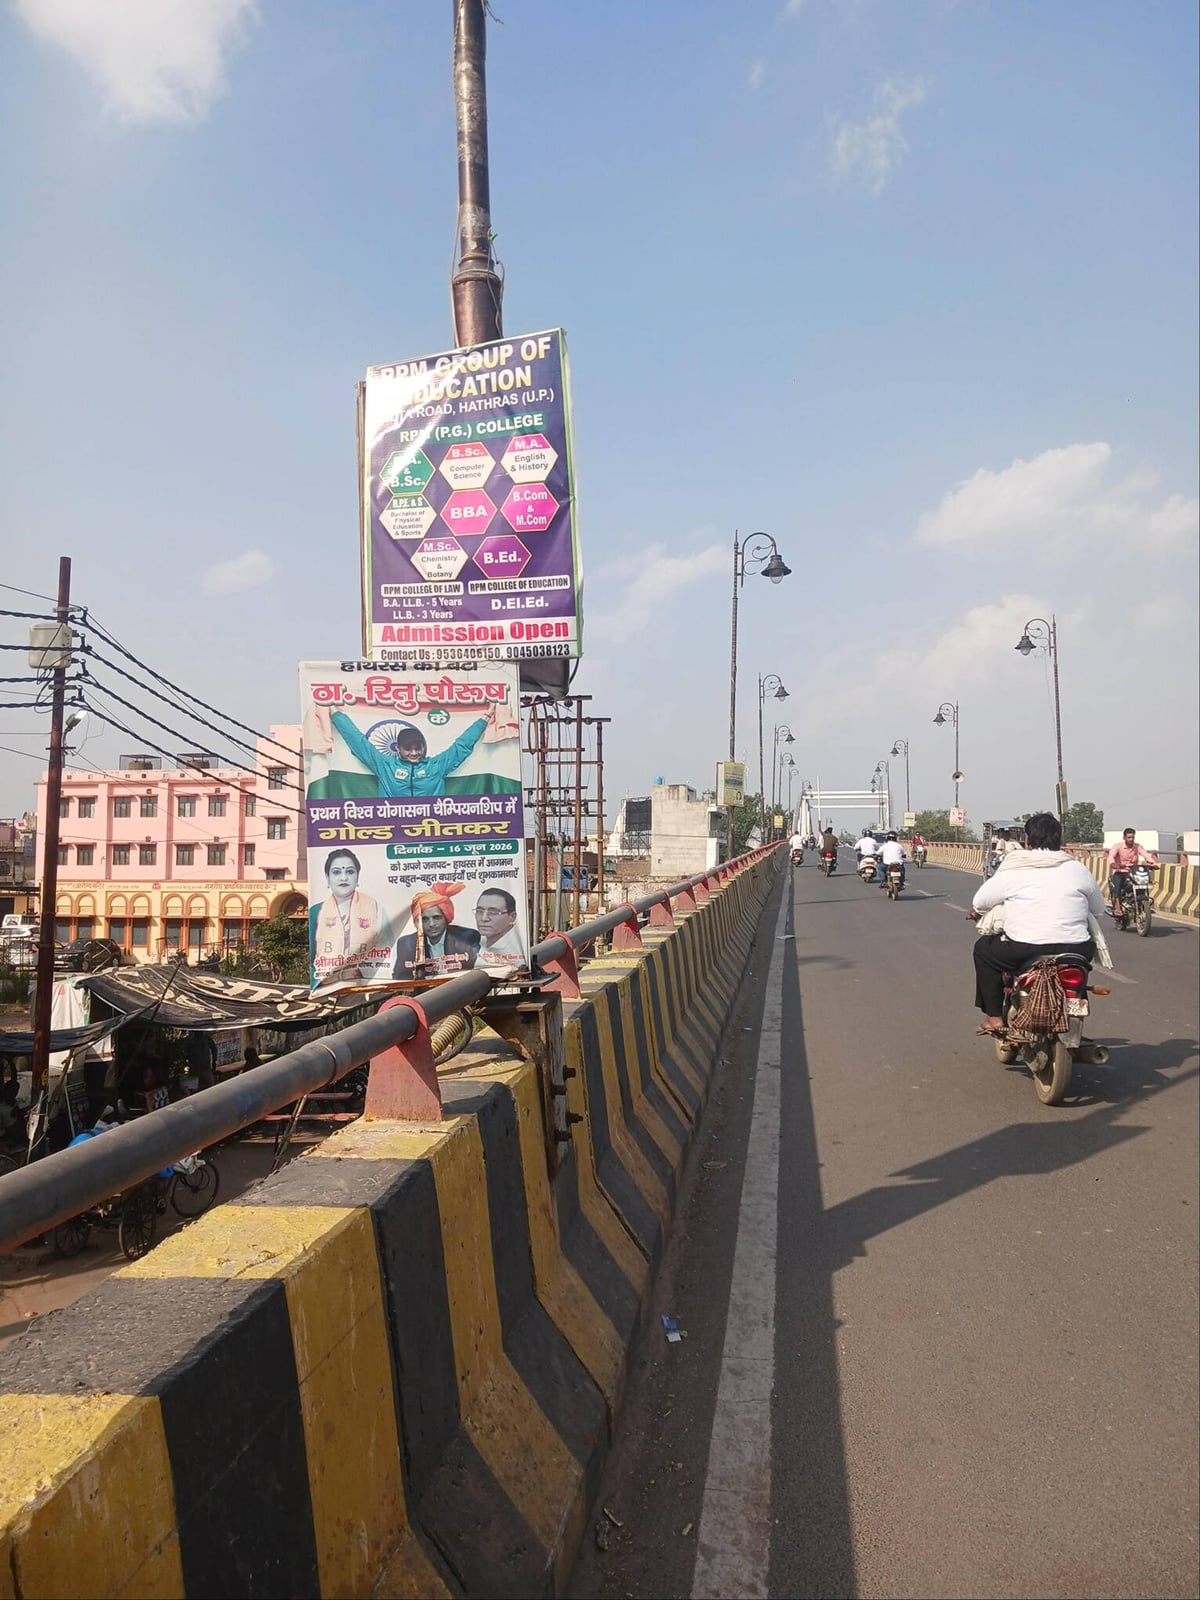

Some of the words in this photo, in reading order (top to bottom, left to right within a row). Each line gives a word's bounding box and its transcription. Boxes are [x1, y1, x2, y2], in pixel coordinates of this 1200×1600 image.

[435, 344, 513, 377] GROUP
[520, 336, 551, 361] OF
[408, 365, 532, 405] DUCATION
[416, 402, 455, 418] ROAD,
[459, 393, 518, 413] HATHRAS
[522, 388, 554, 406] (U.P.)
[435, 424, 472, 441] (P.G.)
[476, 414, 543, 434] COLLEGE
[514, 438, 543, 450] M.A.
[452, 446, 484, 459] B.Sc.
[515, 453, 546, 463] English
[449, 463, 485, 473] Computer
[511, 464, 516, 472] &
[519, 461, 549, 472] History
[453, 471, 482, 480] Science
[513, 490, 548, 502] B.Com
[450, 505, 488, 519] BBA
[527, 505, 534, 513] &
[393, 523, 423, 531] Education
[516, 515, 547, 526] M.Com
[423, 542, 455, 552] M.Sc.
[421, 555, 457, 564] Chemistry
[483, 551, 522, 564] B.Ed.
[383, 586, 400, 595] RPM
[402, 585, 432, 594] COLLEGE
[433, 584, 442, 593] OF
[444, 583, 461, 593] LAW
[470, 583, 487, 592] RPM
[488, 581, 517, 591] COLLEGE
[519, 580, 528, 590] OF
[529, 577, 568, 589] EDUCATION
[383, 598, 400, 607] B.A.
[403, 598, 424, 607] LL.B.
[438, 597, 463, 606] Years
[393, 610, 415, 620] LL.B.
[430, 610, 454, 619] Years
[381, 624, 505, 643] Admission
[510, 621, 569, 641] Open
[381, 648, 417, 661] Contact
[507, 644, 570, 658] 9045038123
[311, 683, 356, 703] ठा.
[364, 676, 417, 711] रितु
[428, 711, 448, 724] के
[310, 807, 340, 823] प्रथम
[344, 801, 374, 819] विश्व
[377, 801, 431, 818] योगासना
[433, 797, 502, 816] चैम्पियनशिप
[505, 797, 518, 814] में
[318, 822, 395, 840] गोल्ड
[401, 818, 510, 836] जीतकर
[394, 843, 434, 855] दिनांक
[464, 844, 486, 856] जून
[490, 843, 513, 851] 2026
[390, 861, 401, 872] को
[402, 860, 421, 871] अपने
[388, 875, 398, 884] पर
[466, 869, 478, 880] एवं
[315, 954, 344, 968] श्रीमती
